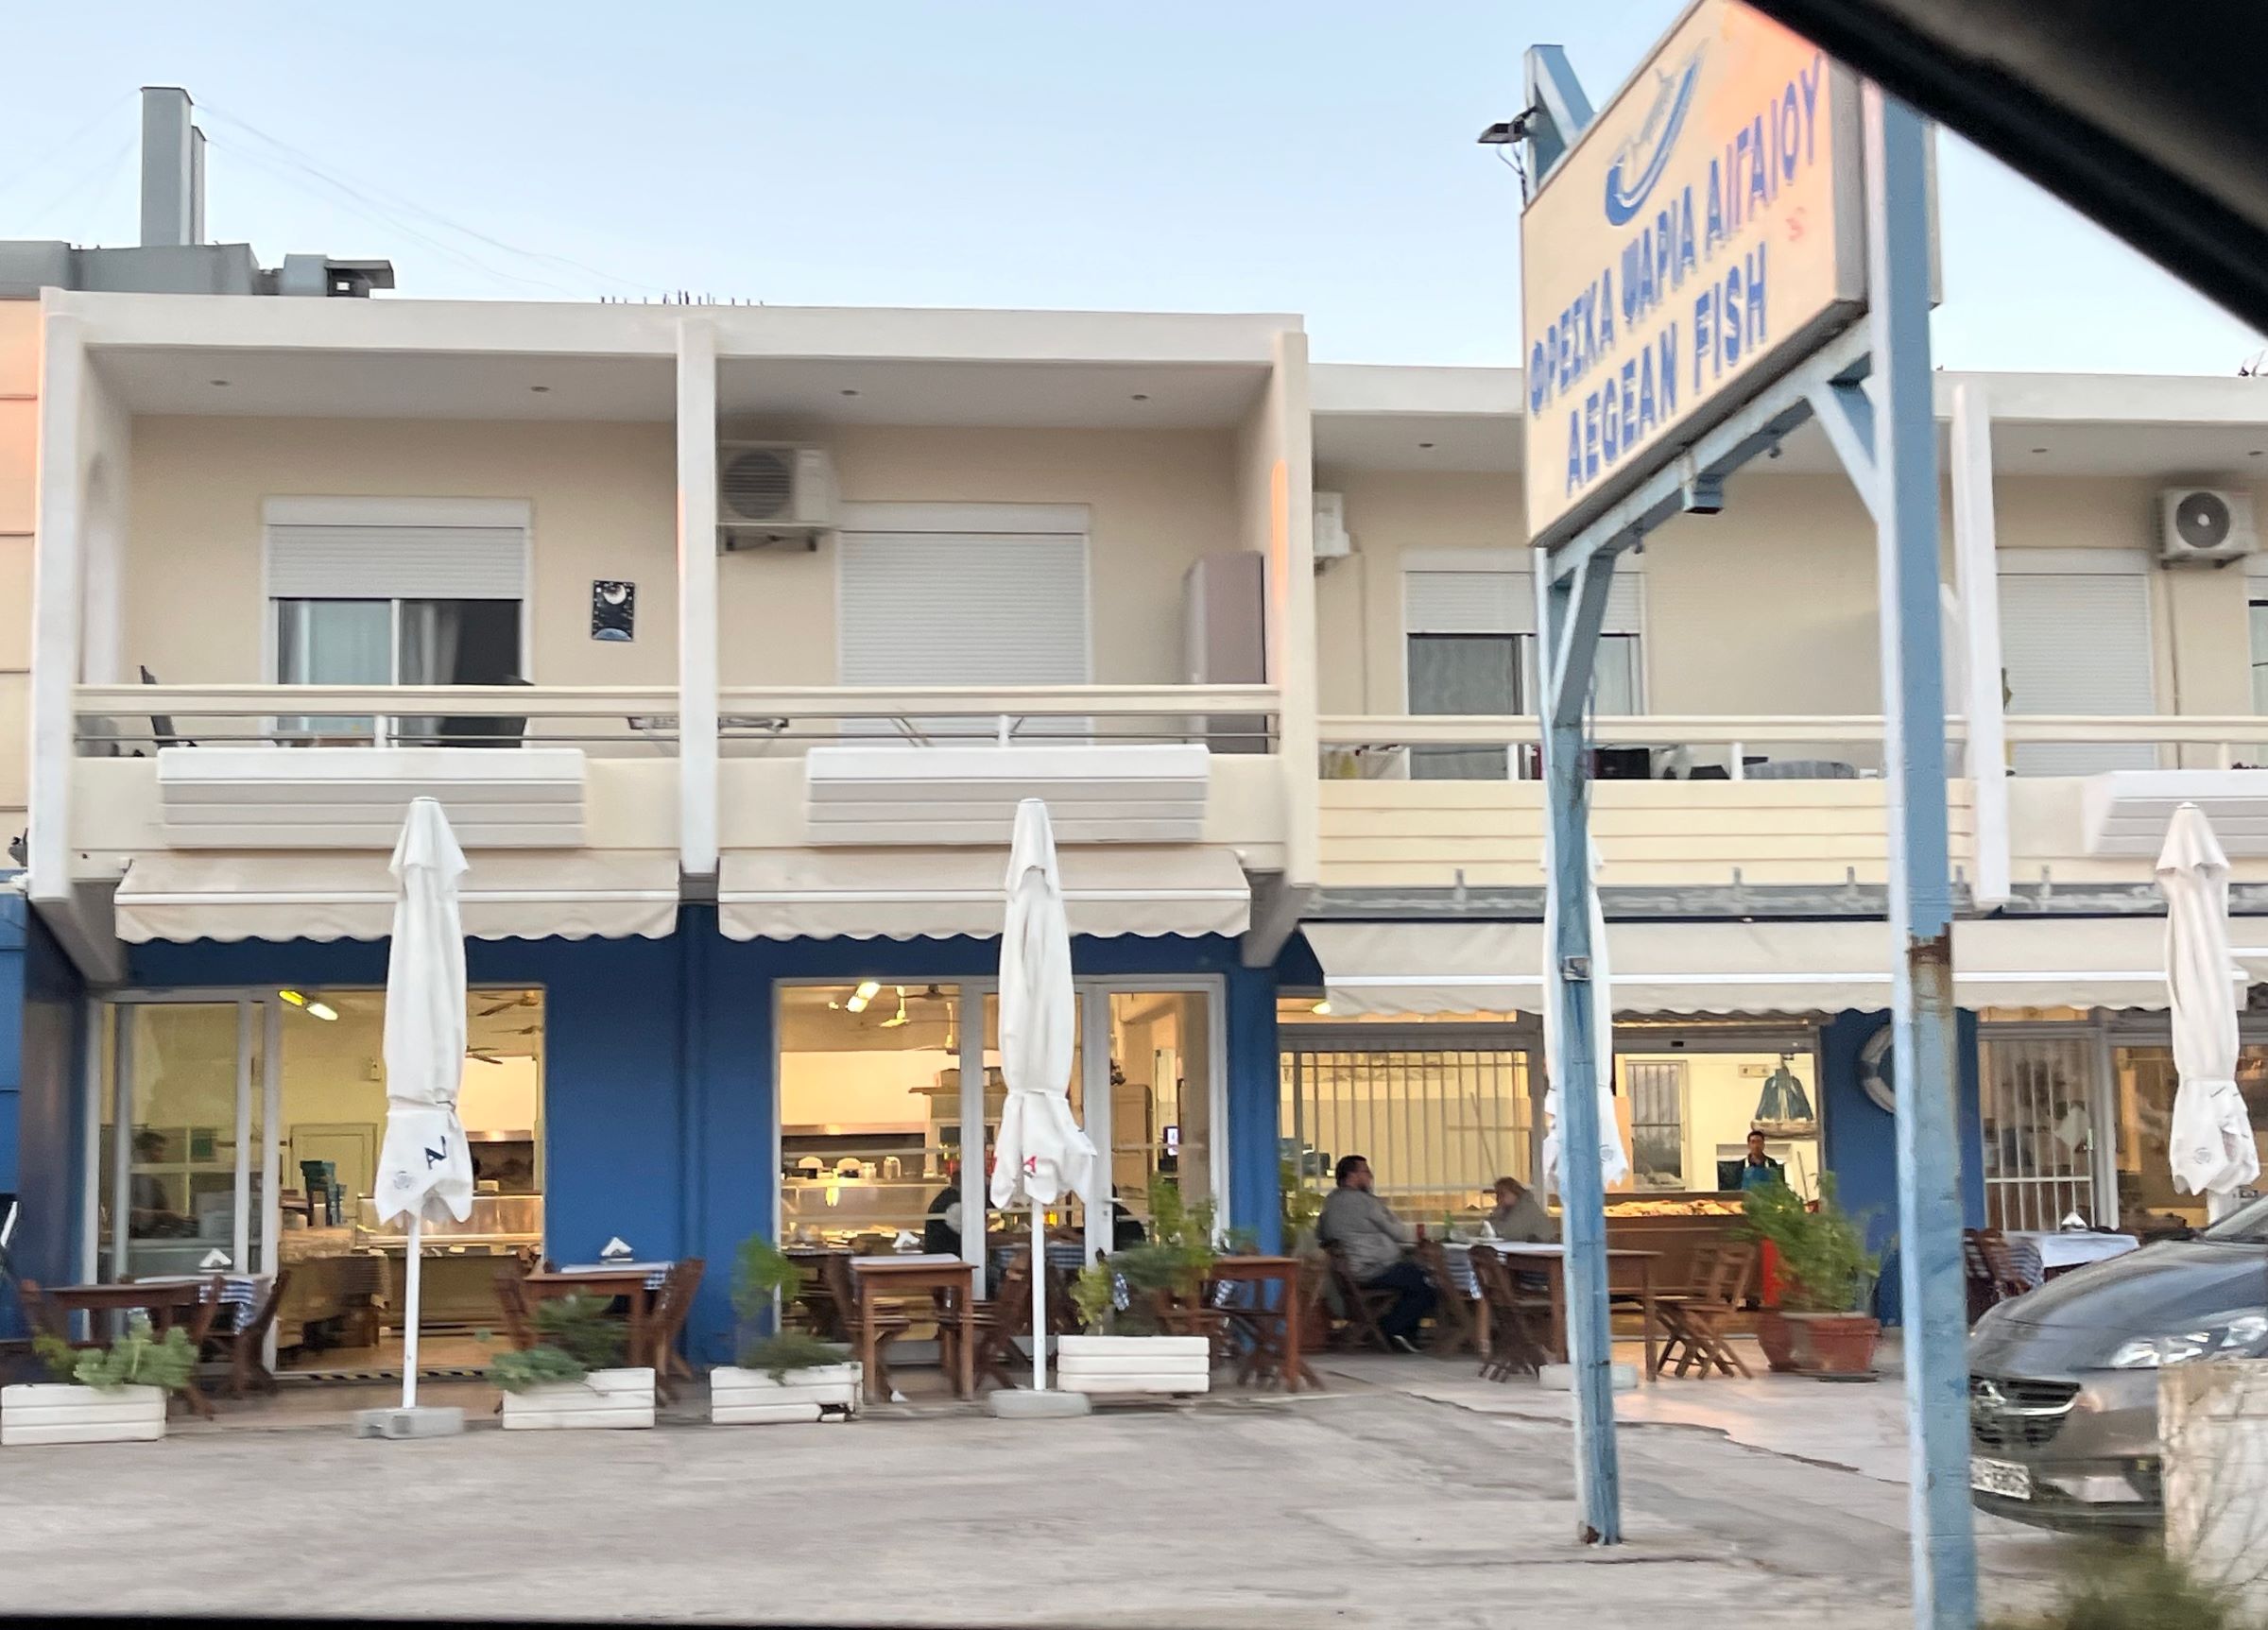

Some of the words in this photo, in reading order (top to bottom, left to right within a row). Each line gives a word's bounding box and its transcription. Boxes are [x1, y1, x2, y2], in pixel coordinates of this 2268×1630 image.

[1705, 52, 1821, 257] ΑΙΓΑΙΟΥ
[1566, 319, 1678, 498] AEGEAN
[1693, 240, 1767, 395] FISH
